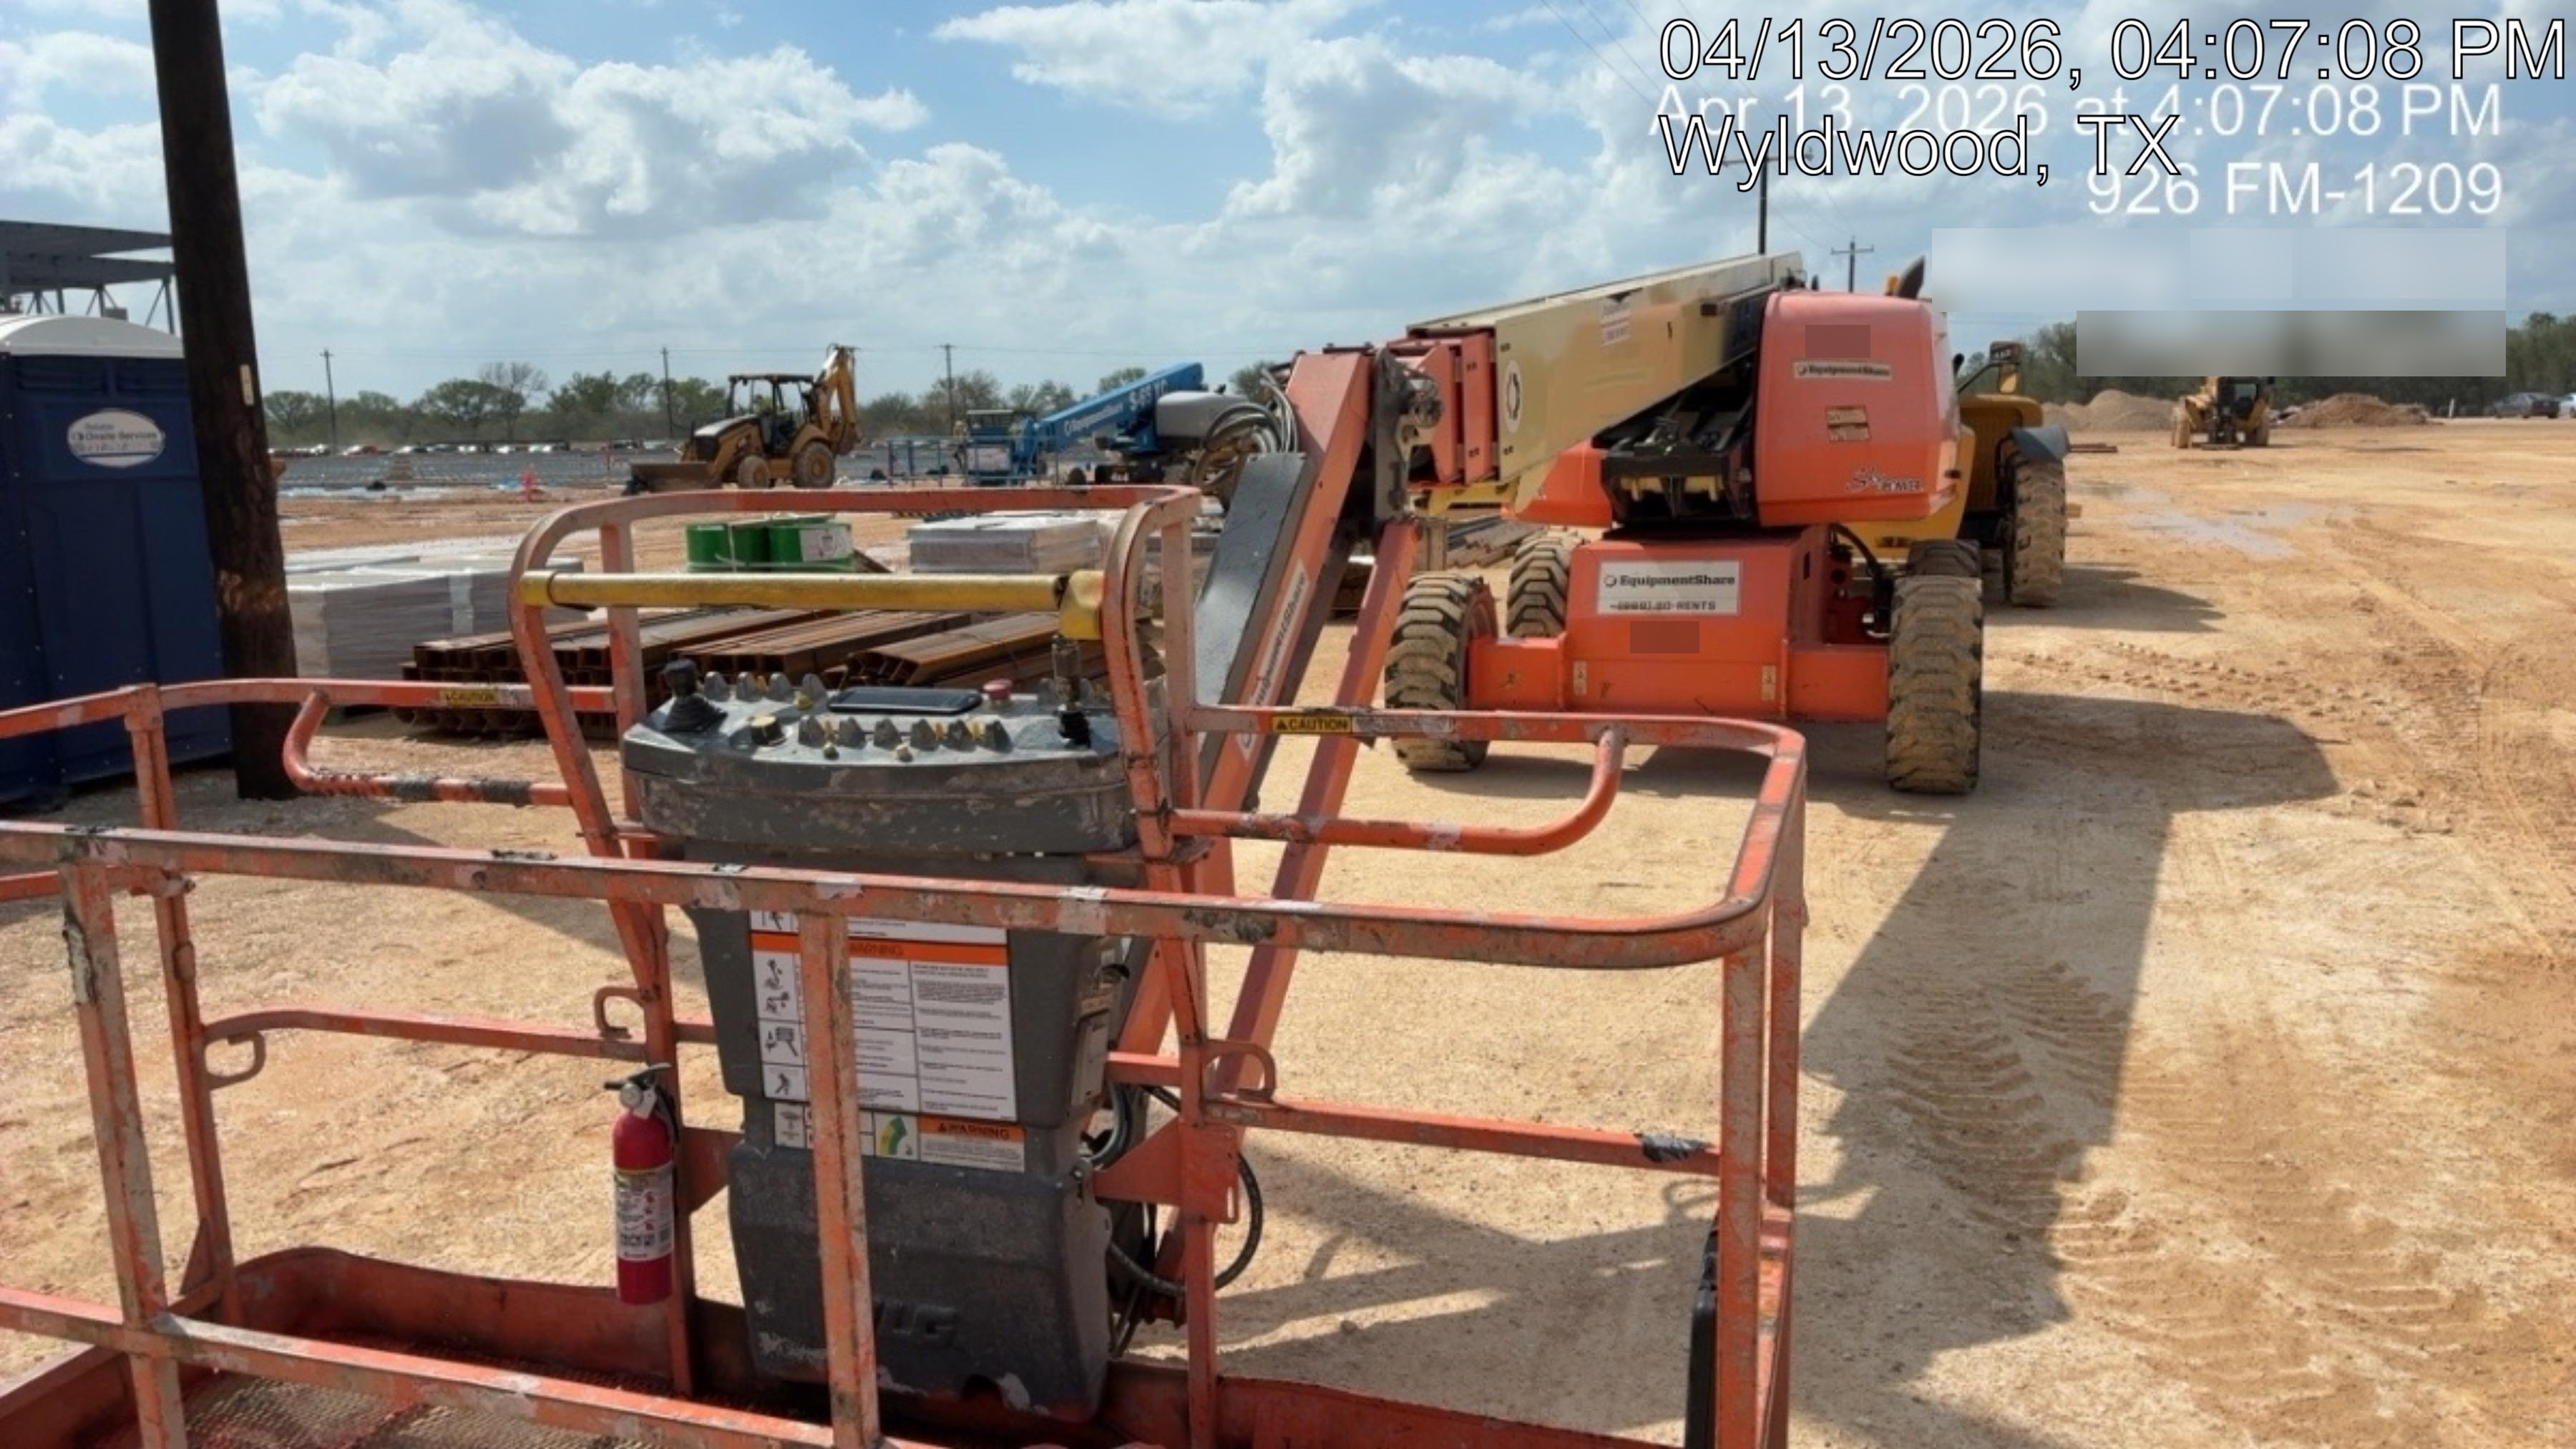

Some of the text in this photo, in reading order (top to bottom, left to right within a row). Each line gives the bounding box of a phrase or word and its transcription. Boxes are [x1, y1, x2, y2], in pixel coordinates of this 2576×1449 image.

[1619, 575, 1736, 588] EquipmentShare
[1289, 718, 1349, 731] CAUTION
[949, 1123, 1010, 1140] WARNING
